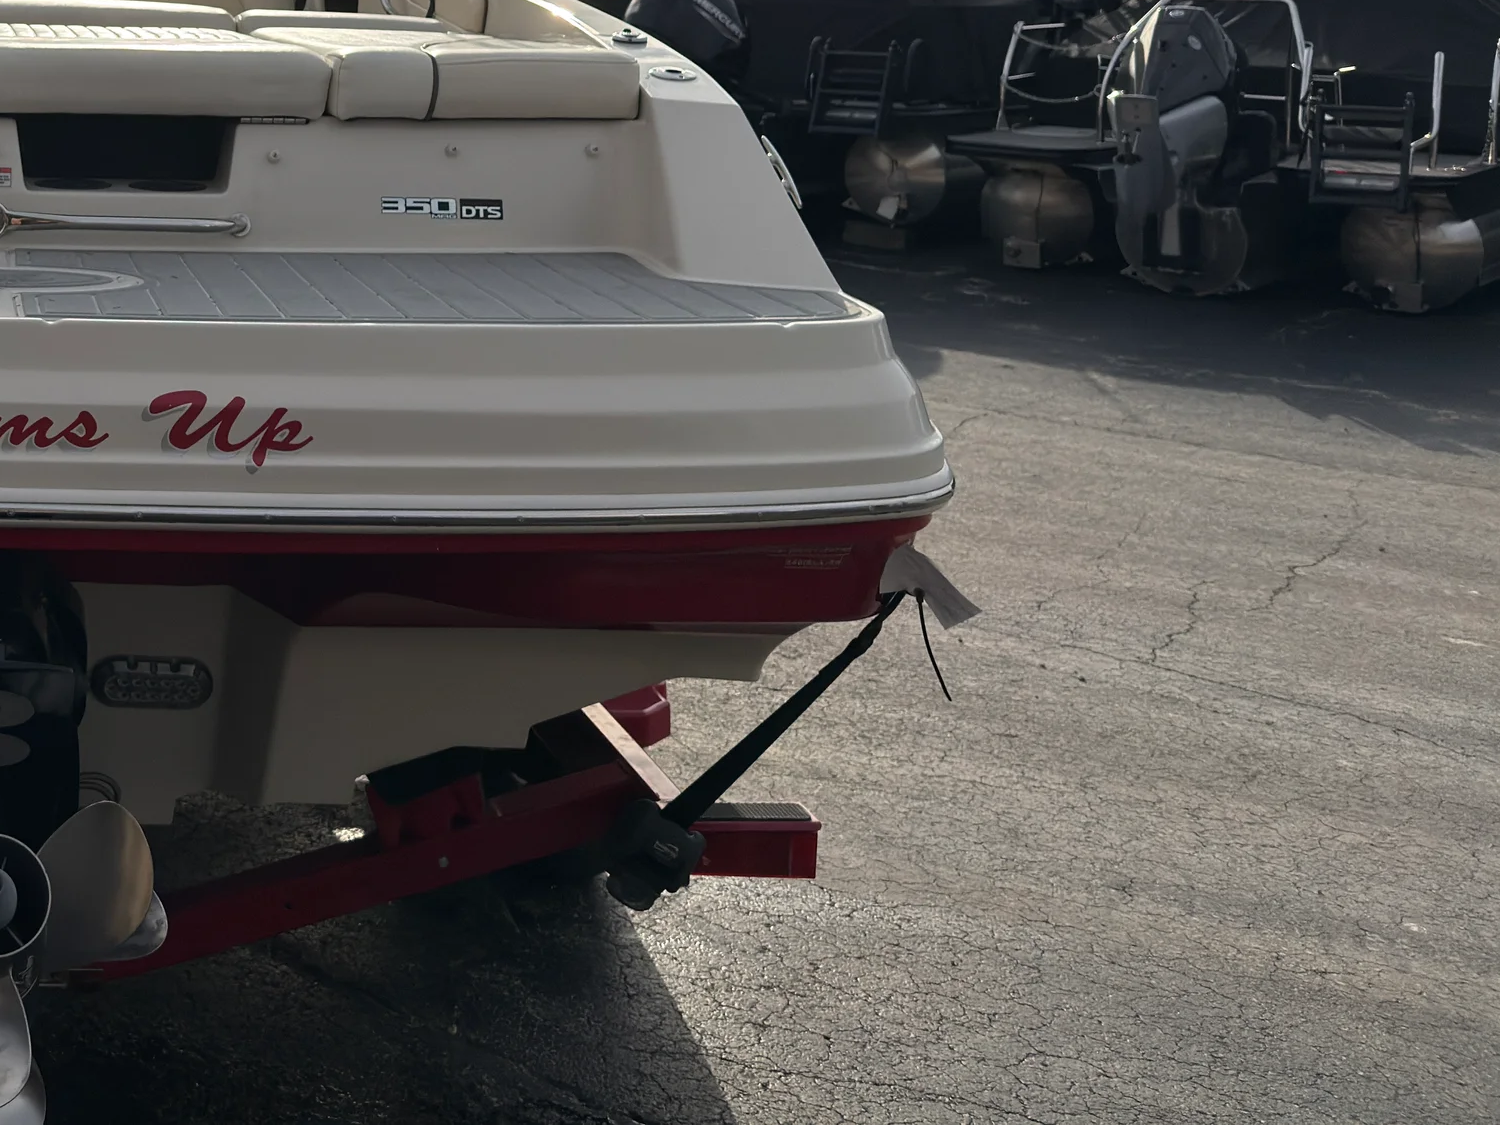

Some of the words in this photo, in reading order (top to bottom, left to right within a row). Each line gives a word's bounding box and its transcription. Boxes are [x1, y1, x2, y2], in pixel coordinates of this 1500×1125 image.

[381, 197, 457, 214] 350
[462, 206, 501, 218] DTS
[144, 390, 314, 475] Up
